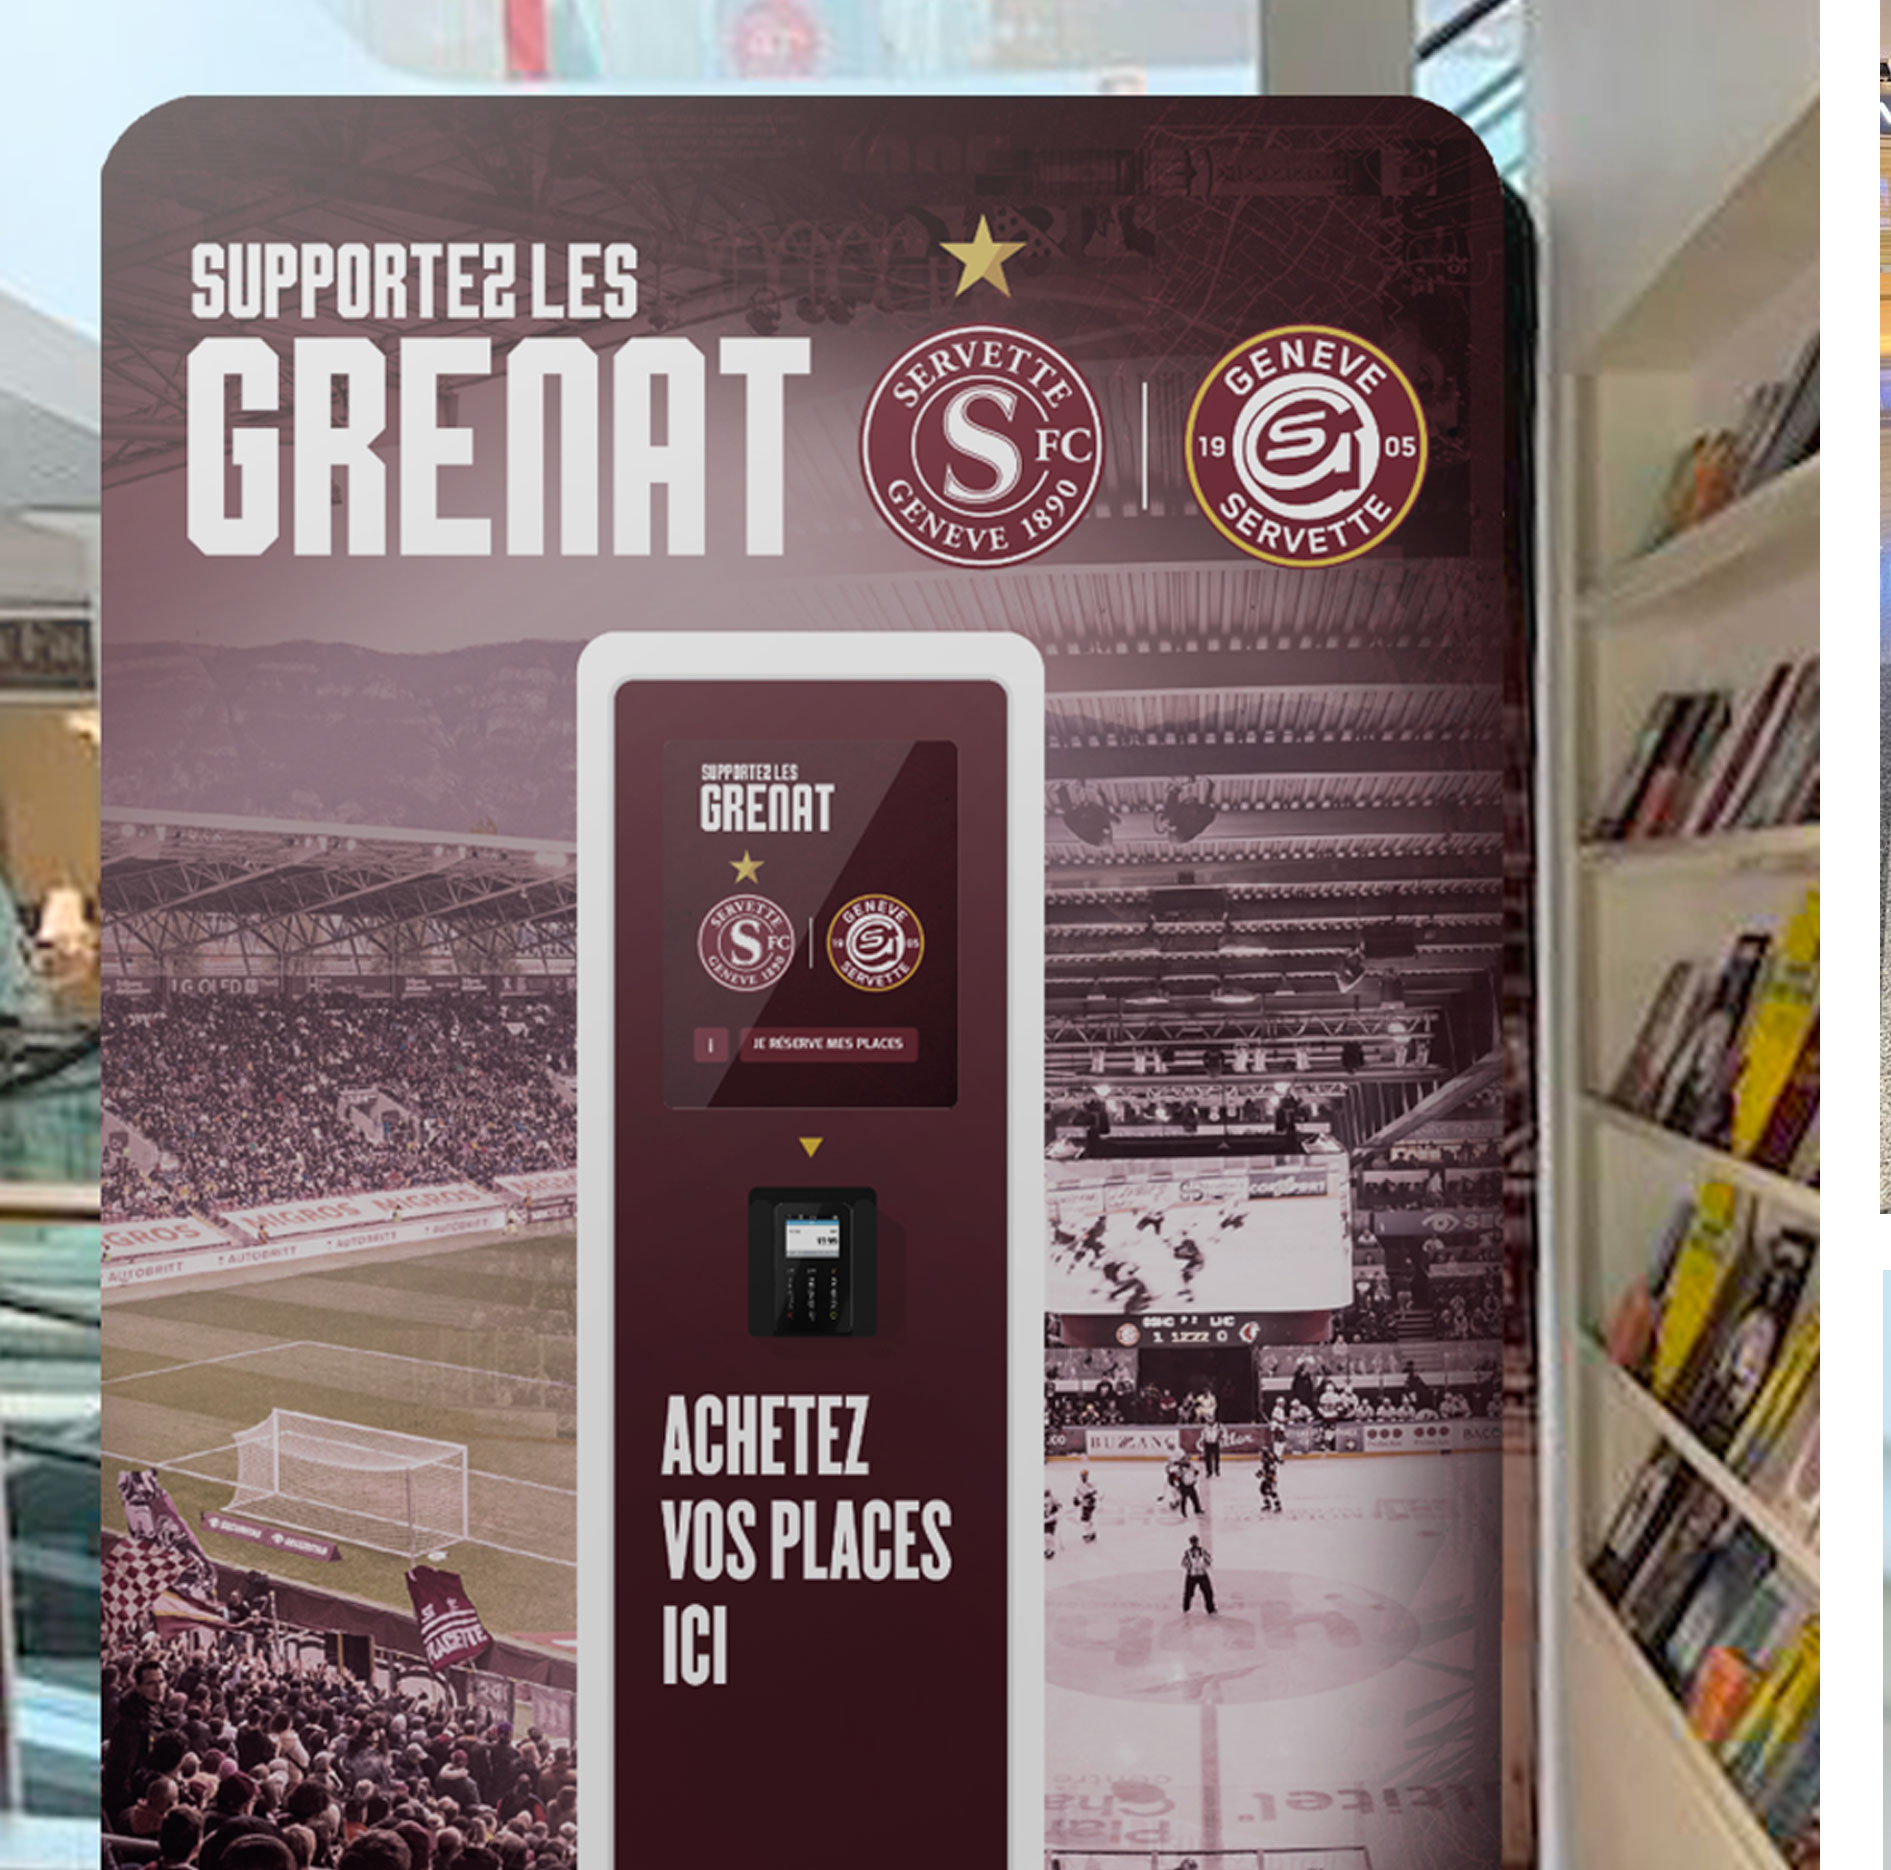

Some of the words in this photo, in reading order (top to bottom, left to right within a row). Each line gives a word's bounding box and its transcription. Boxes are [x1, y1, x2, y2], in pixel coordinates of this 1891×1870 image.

[191, 243, 516, 319] SUPPORTEZ
[532, 243, 638, 319] LES
[893, 339, 1072, 407] SERVETTE
[1222, 339, 1387, 397] GENEVE
[187, 337, 811, 556] GRENAT
[1036, 429, 1092, 463] FC
[1199, 436, 1225, 458] 19
[1385, 436, 1416, 458] 05
[1218, 493, 1393, 555] SERVETTE
[774, 764, 798, 781] LES
[700, 783, 835, 832] GRENAT
[661, 1394, 869, 1475] ACHETEZ
[661, 1500, 756, 1580] VOS
[771, 1500, 952, 1580] PLACES
[663, 1603, 727, 1685] ICI
